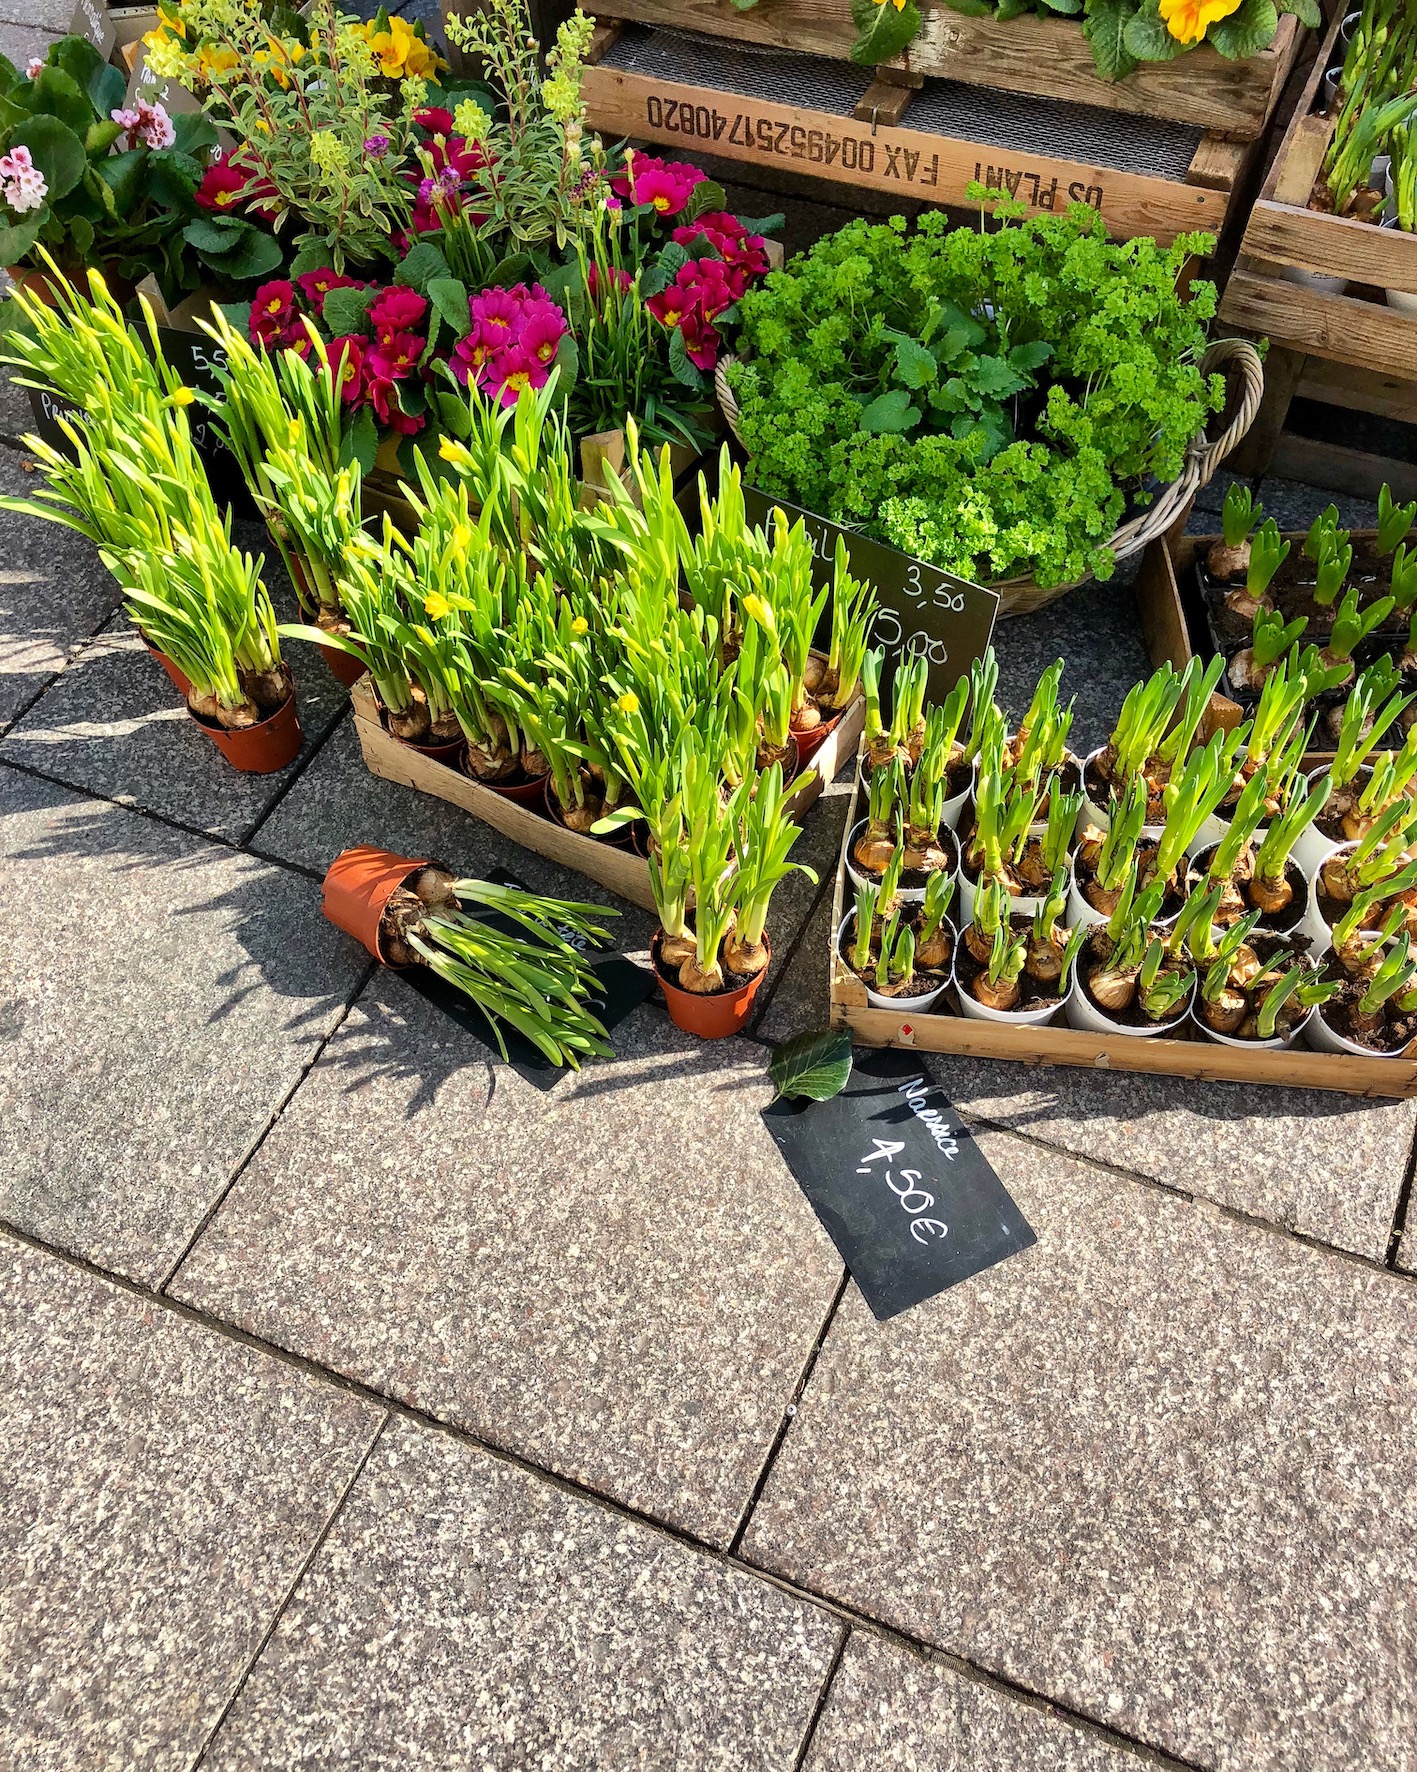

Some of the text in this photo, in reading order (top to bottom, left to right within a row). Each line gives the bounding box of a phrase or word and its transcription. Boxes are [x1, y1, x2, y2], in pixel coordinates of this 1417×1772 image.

[646, 95, 876, 173] 00495251740820
[883, 143, 939, 187] FAX
[902, 564, 966, 613] 3,50
[873, 607, 949, 666] 5,00
[855, 1138, 949, 1246] 4,50€
